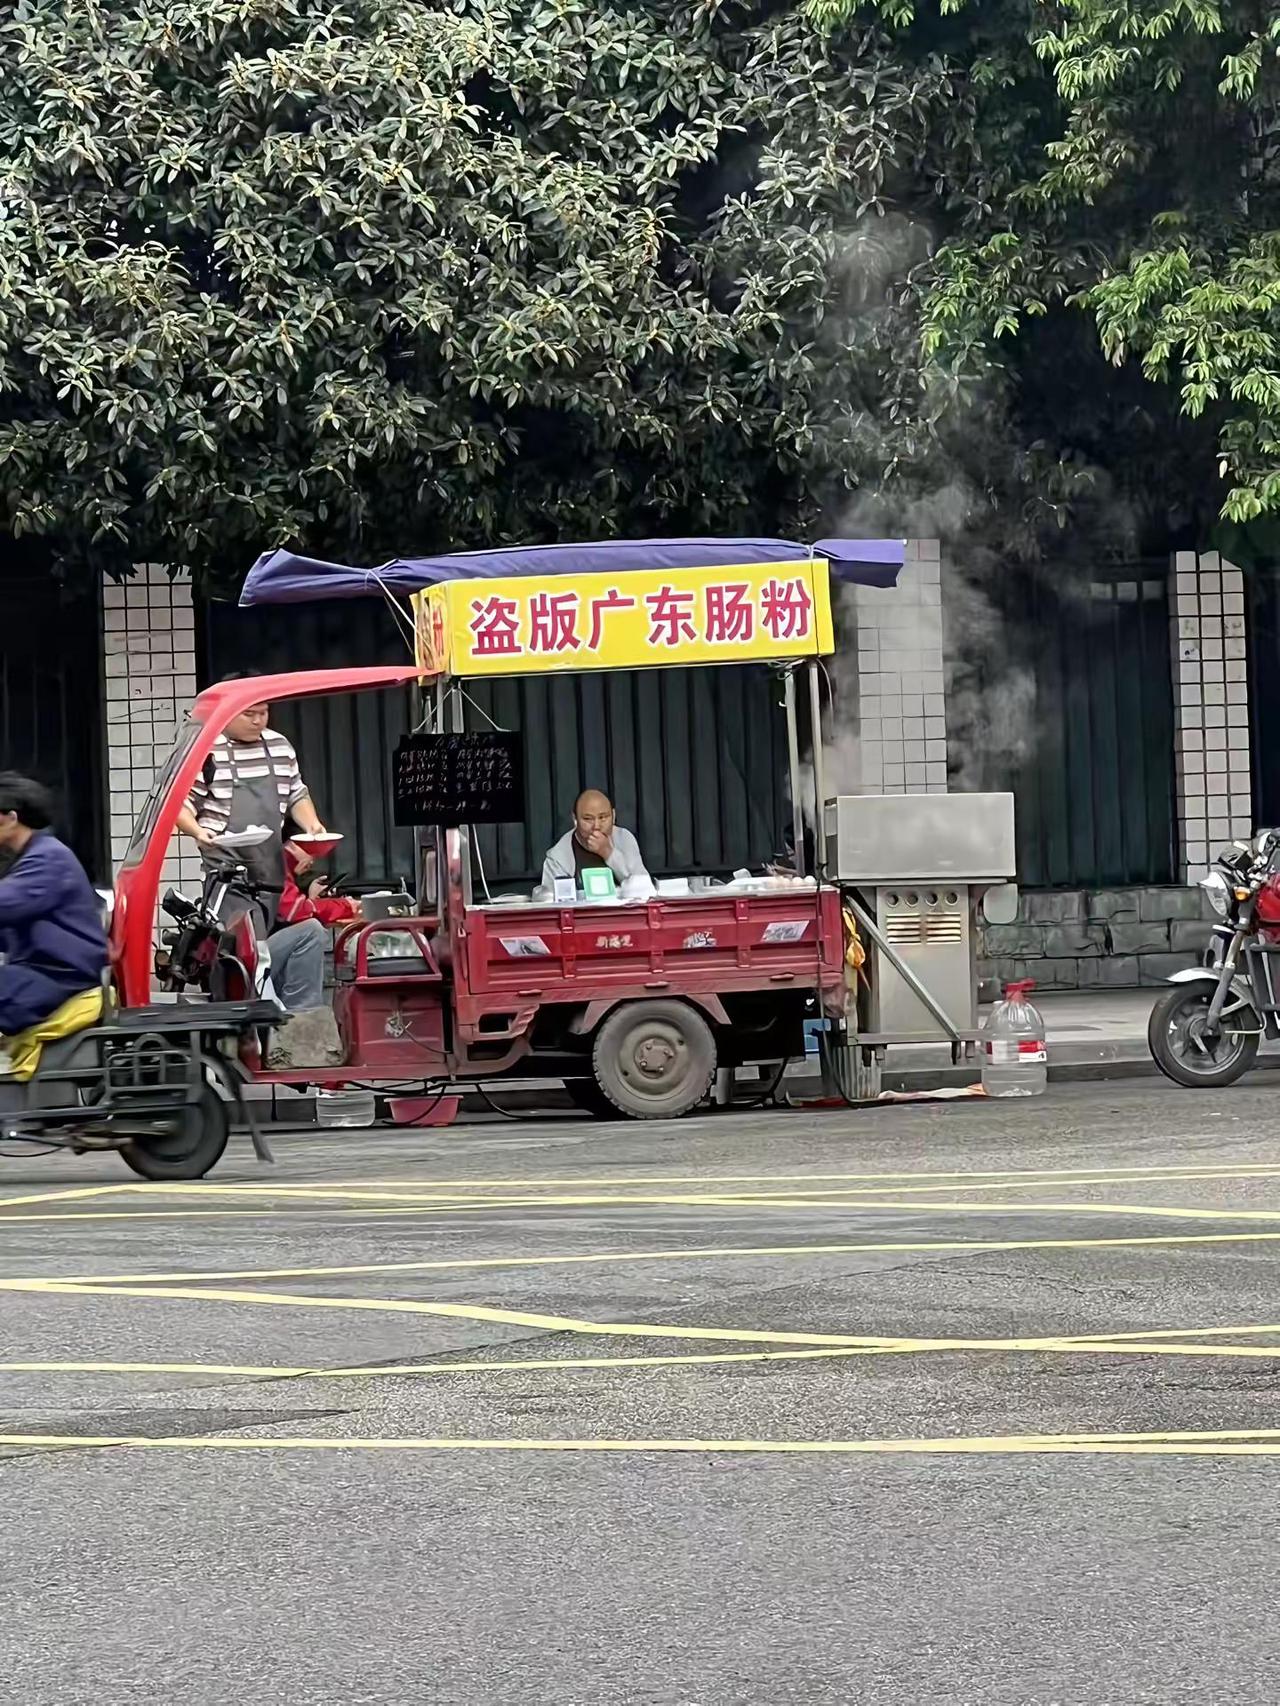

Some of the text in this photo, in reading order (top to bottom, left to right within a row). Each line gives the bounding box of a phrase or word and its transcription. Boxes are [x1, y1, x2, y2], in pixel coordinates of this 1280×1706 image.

[471, 580, 812, 656] 盗版广东肠粉
